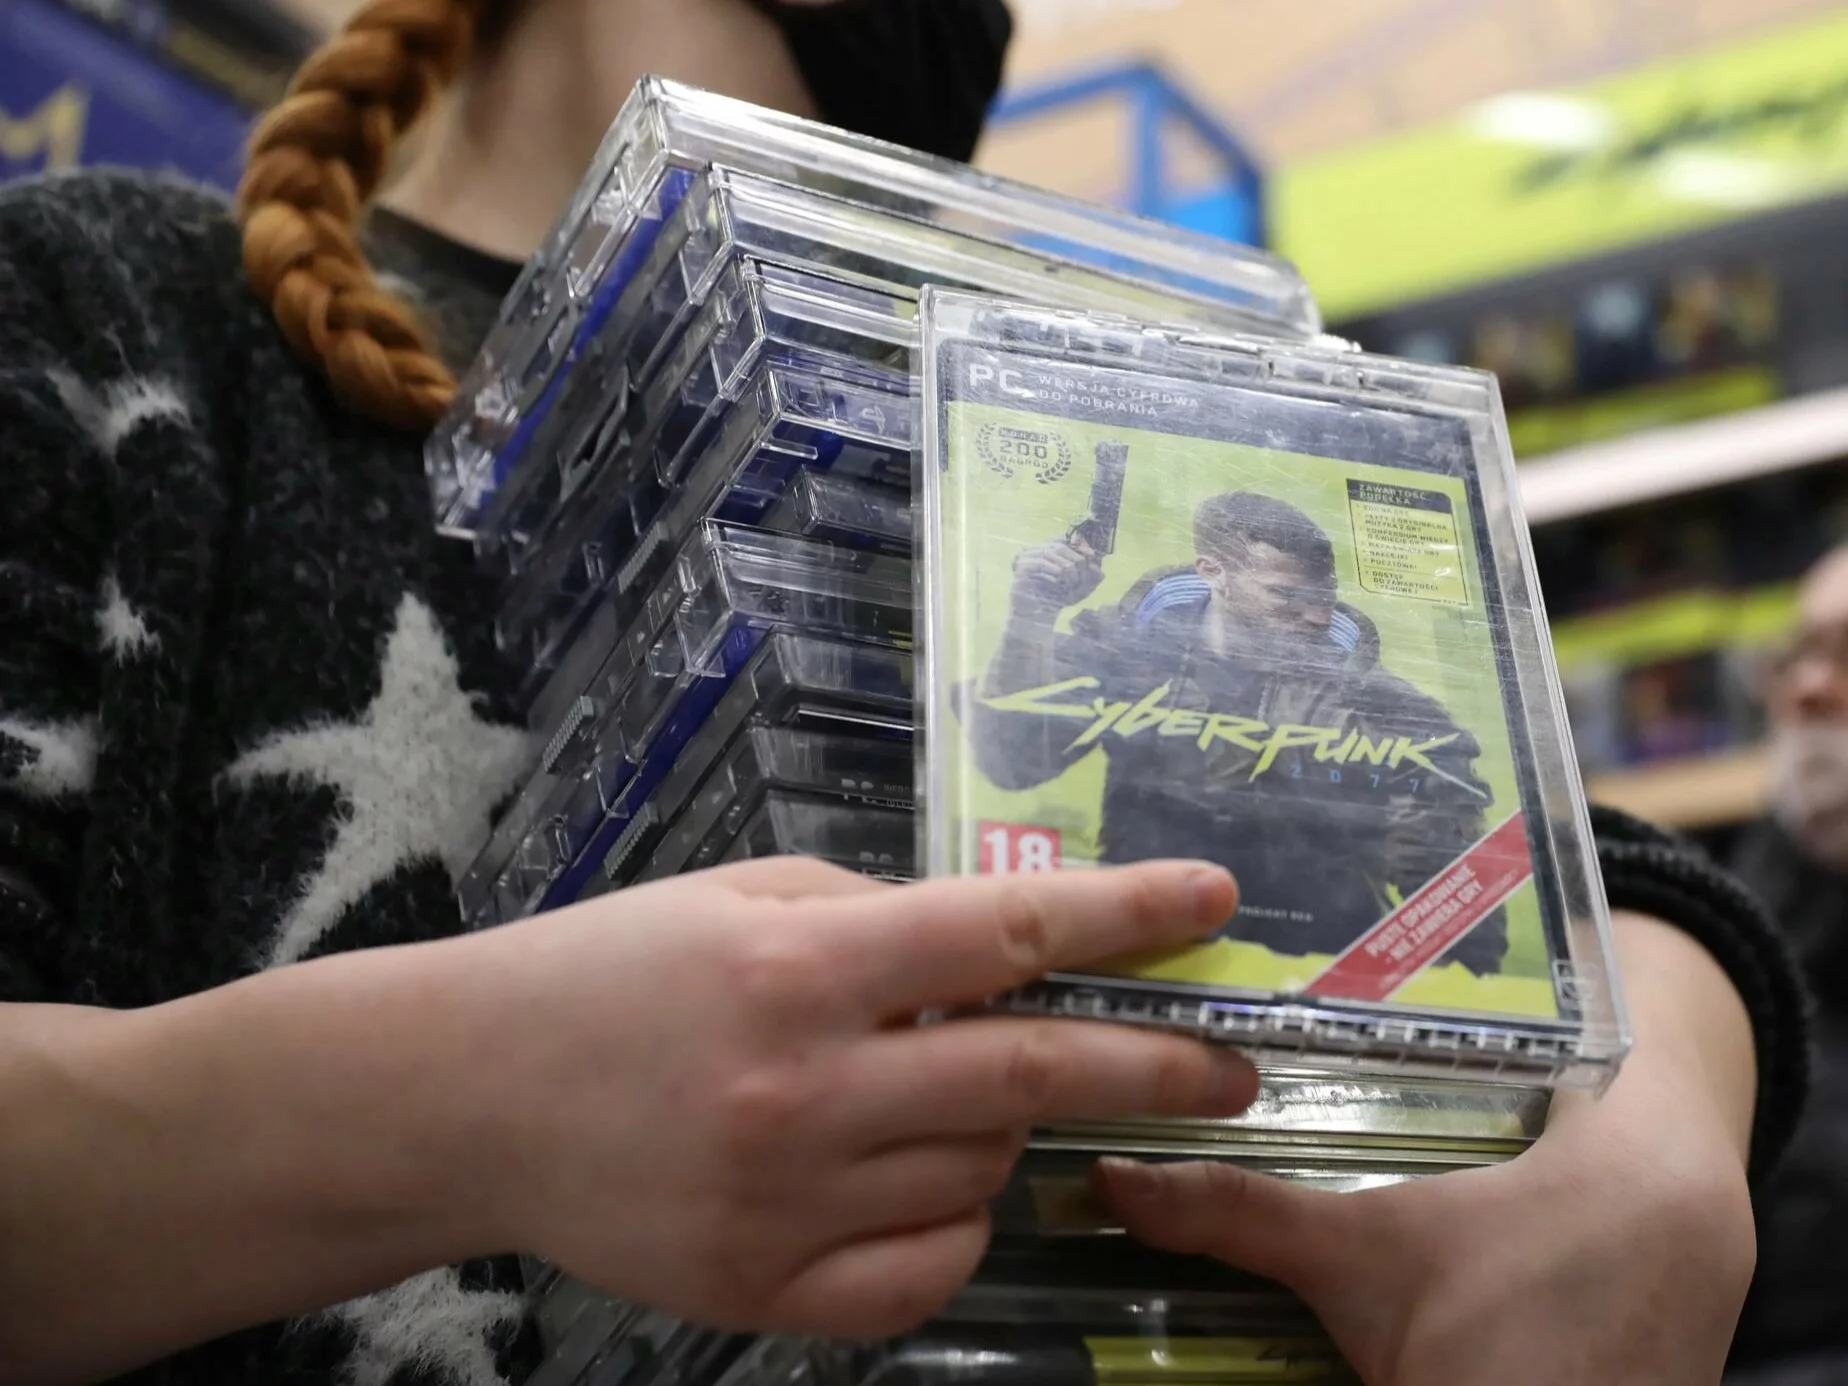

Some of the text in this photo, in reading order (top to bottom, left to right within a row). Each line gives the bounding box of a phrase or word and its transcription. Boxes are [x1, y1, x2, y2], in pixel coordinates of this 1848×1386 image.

[969, 363, 1026, 396] PC
[1040, 375, 1200, 408] WERSJA CYFROWA
[1040, 389, 1158, 417] DO POBRANIA
[999, 439, 1048, 460] 200
[1290, 764, 1422, 794] 2077
[984, 827, 1053, 876] 18
[1456, 878, 1484, 906] GRY
